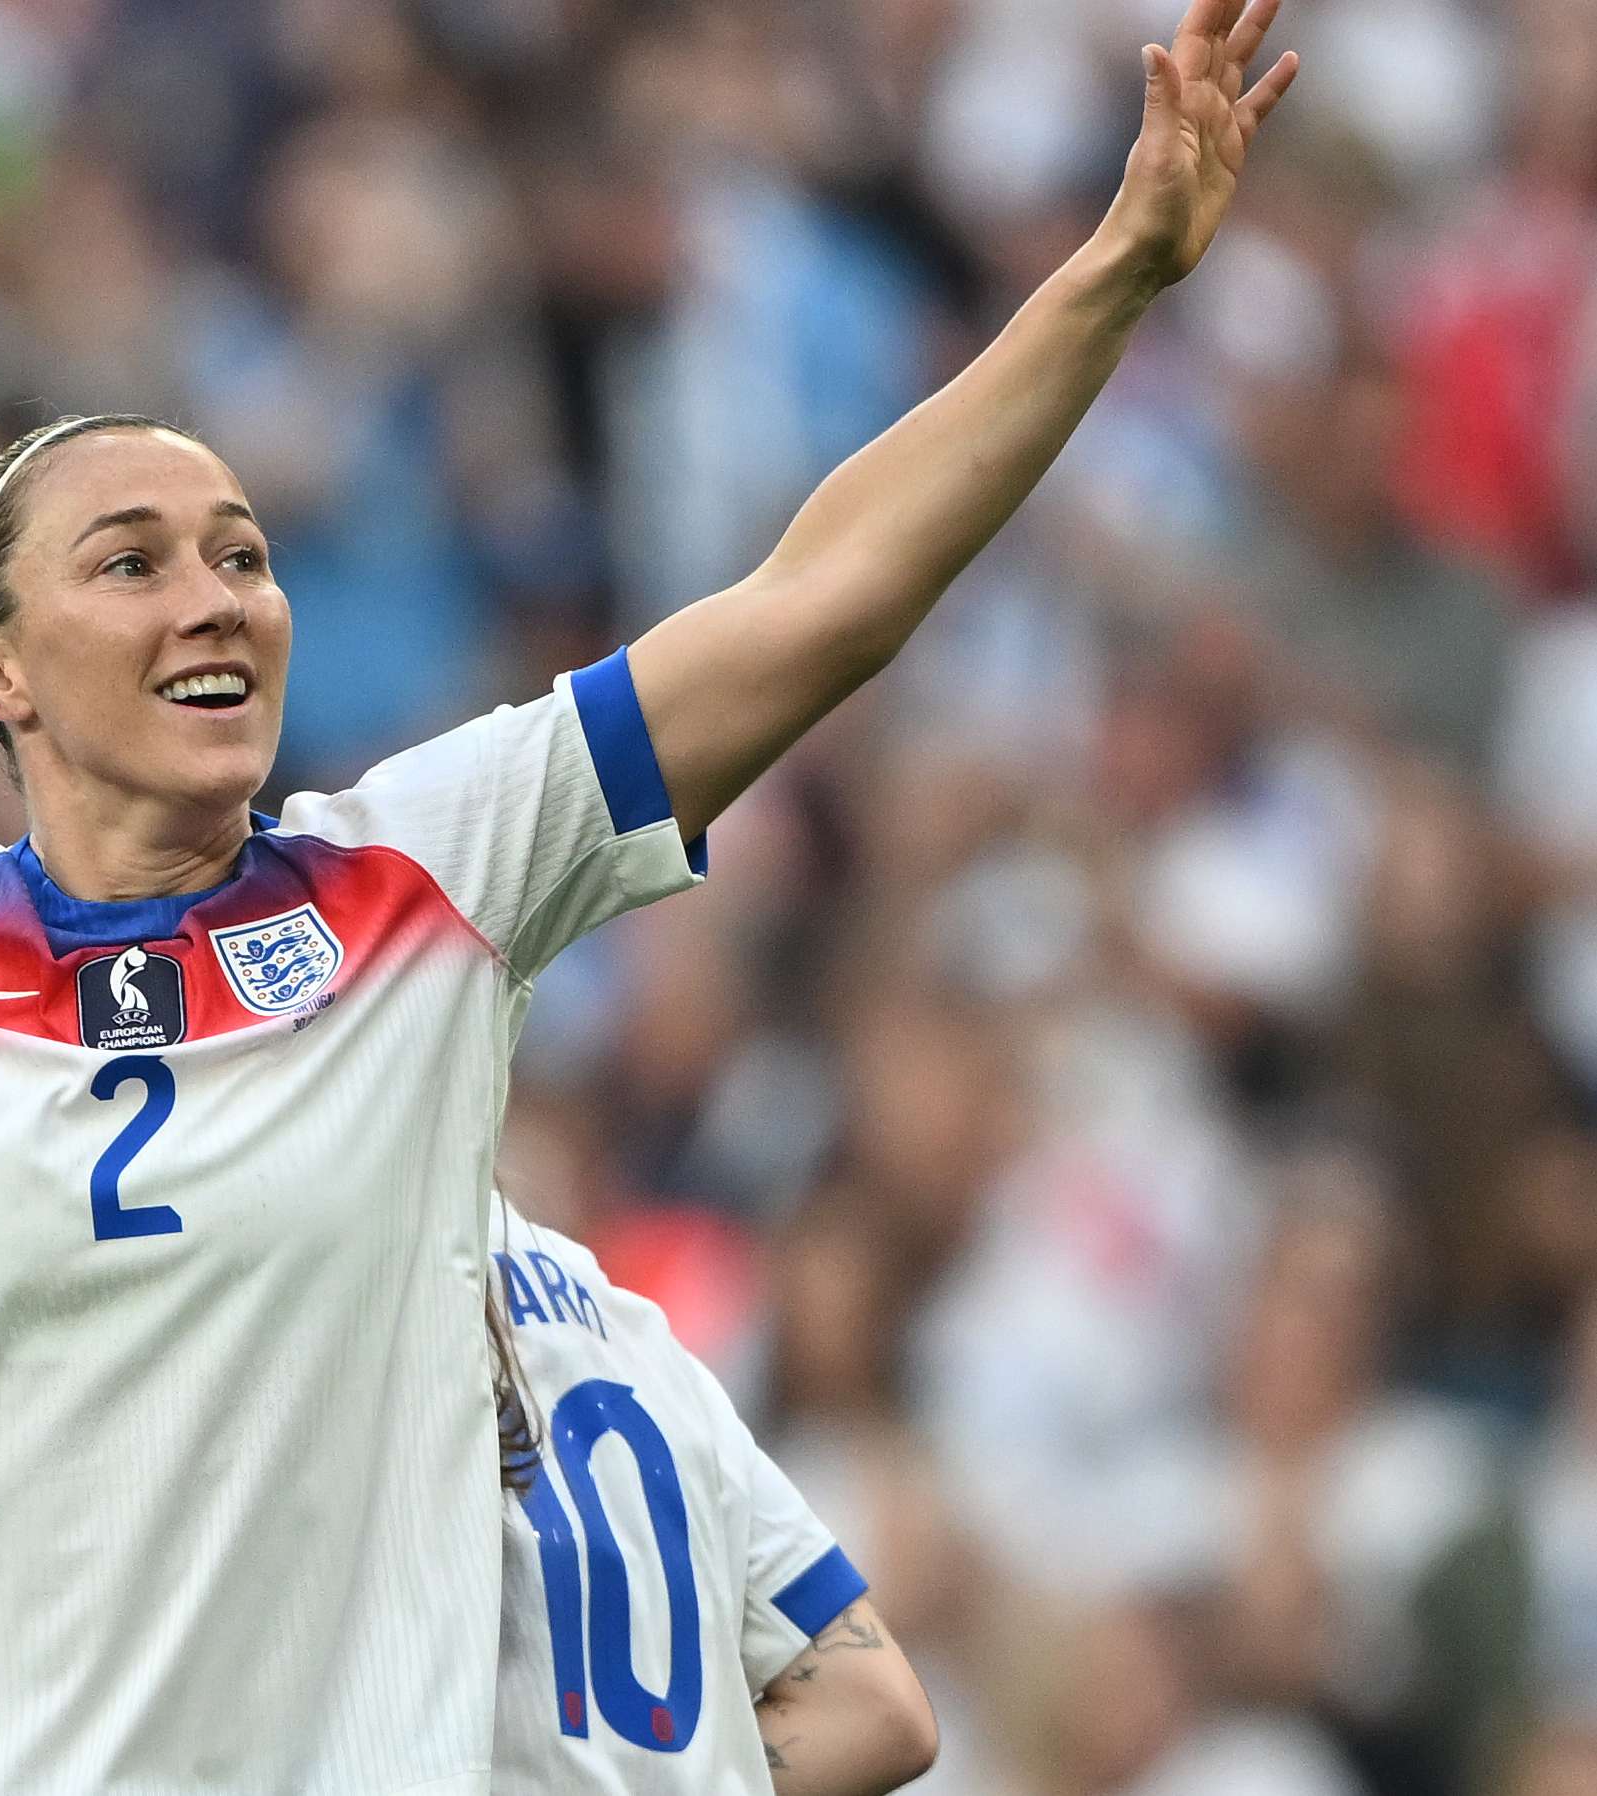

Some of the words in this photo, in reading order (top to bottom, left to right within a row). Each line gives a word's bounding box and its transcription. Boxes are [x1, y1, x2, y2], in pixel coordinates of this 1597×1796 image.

[113, 1010, 149, 1024] UEFA
[99, 1025, 163, 1039] EUROPEAN
[97, 1035, 167, 1050] CHAMPIONS
[90, 1055, 182, 1241] 2
[501, 1378, 702, 1753] 10
